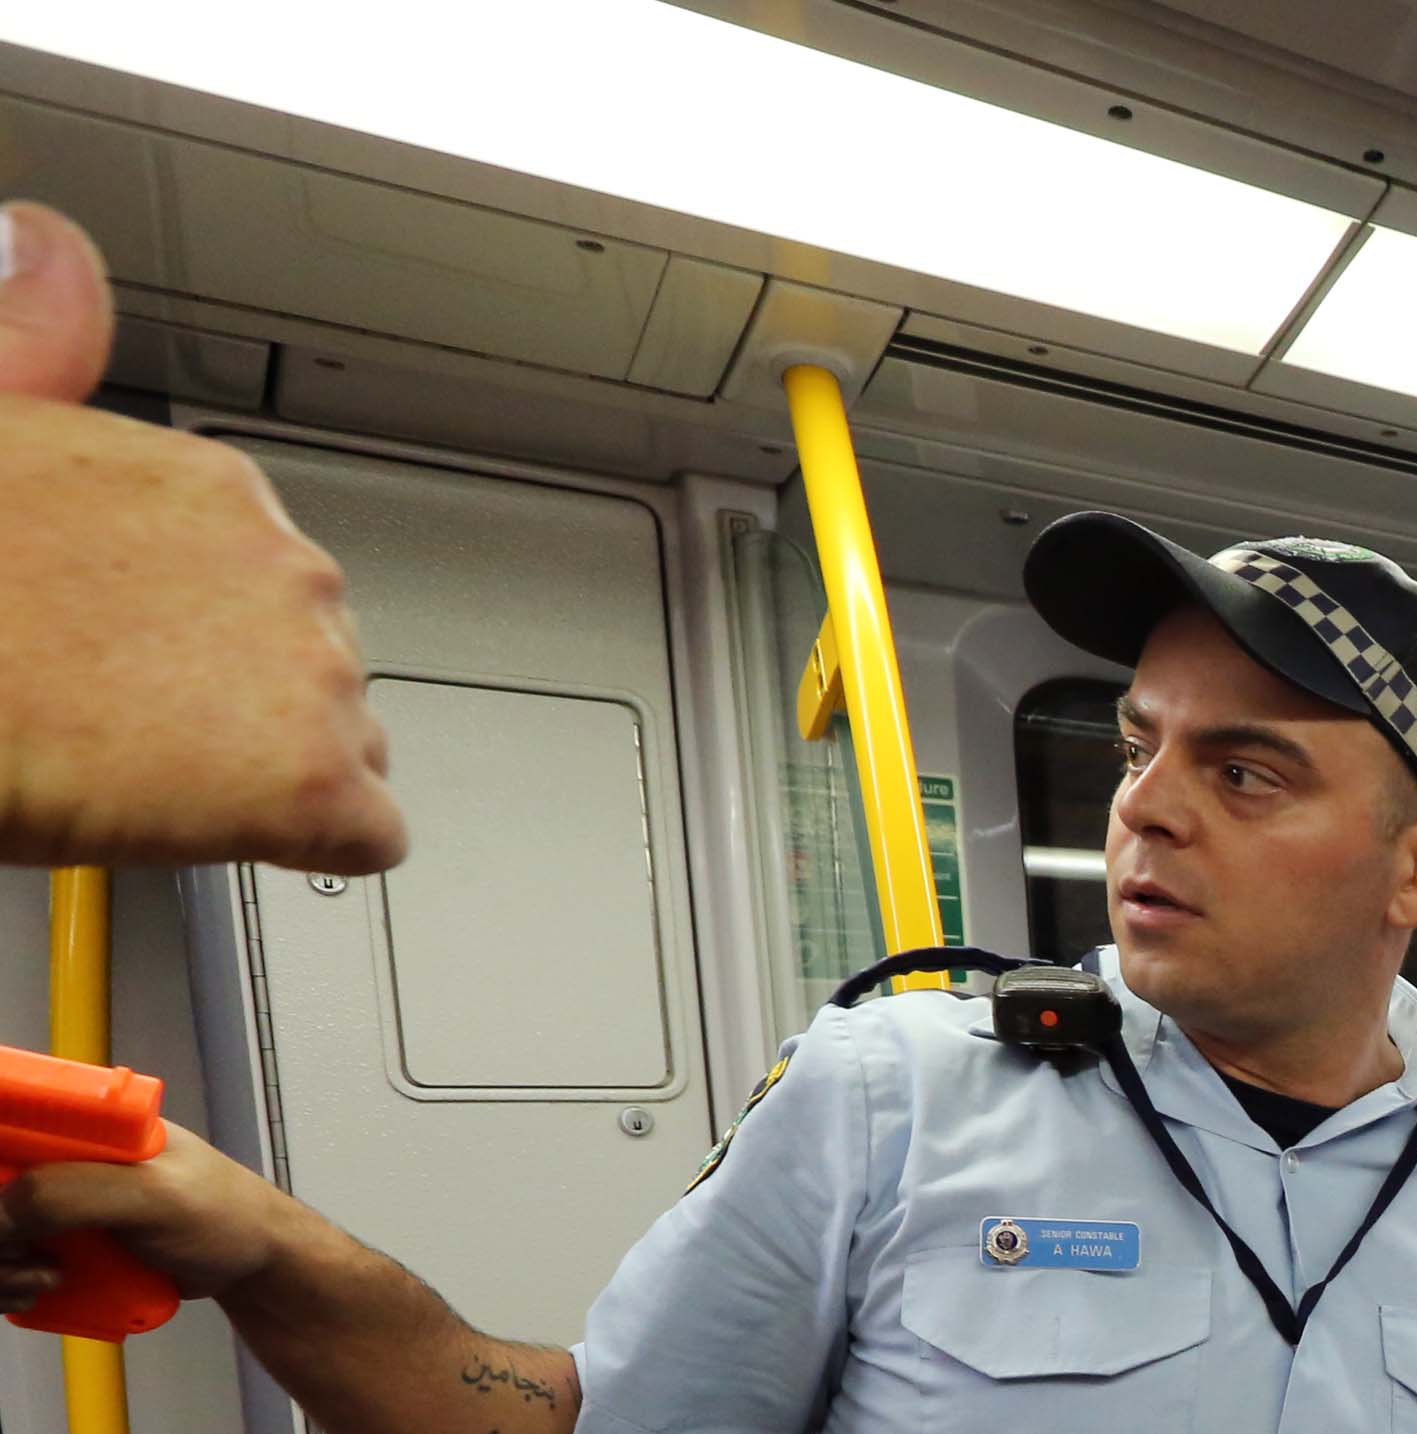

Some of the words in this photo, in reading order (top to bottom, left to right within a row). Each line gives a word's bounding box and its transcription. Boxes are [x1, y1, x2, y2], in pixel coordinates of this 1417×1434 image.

[1040, 1229, 1072, 1239] SENIOR
[1075, 1230, 1125, 1241] CONSTABLE
[1053, 1243, 1063, 1256] A
[1070, 1244, 1113, 1257] HAWA
